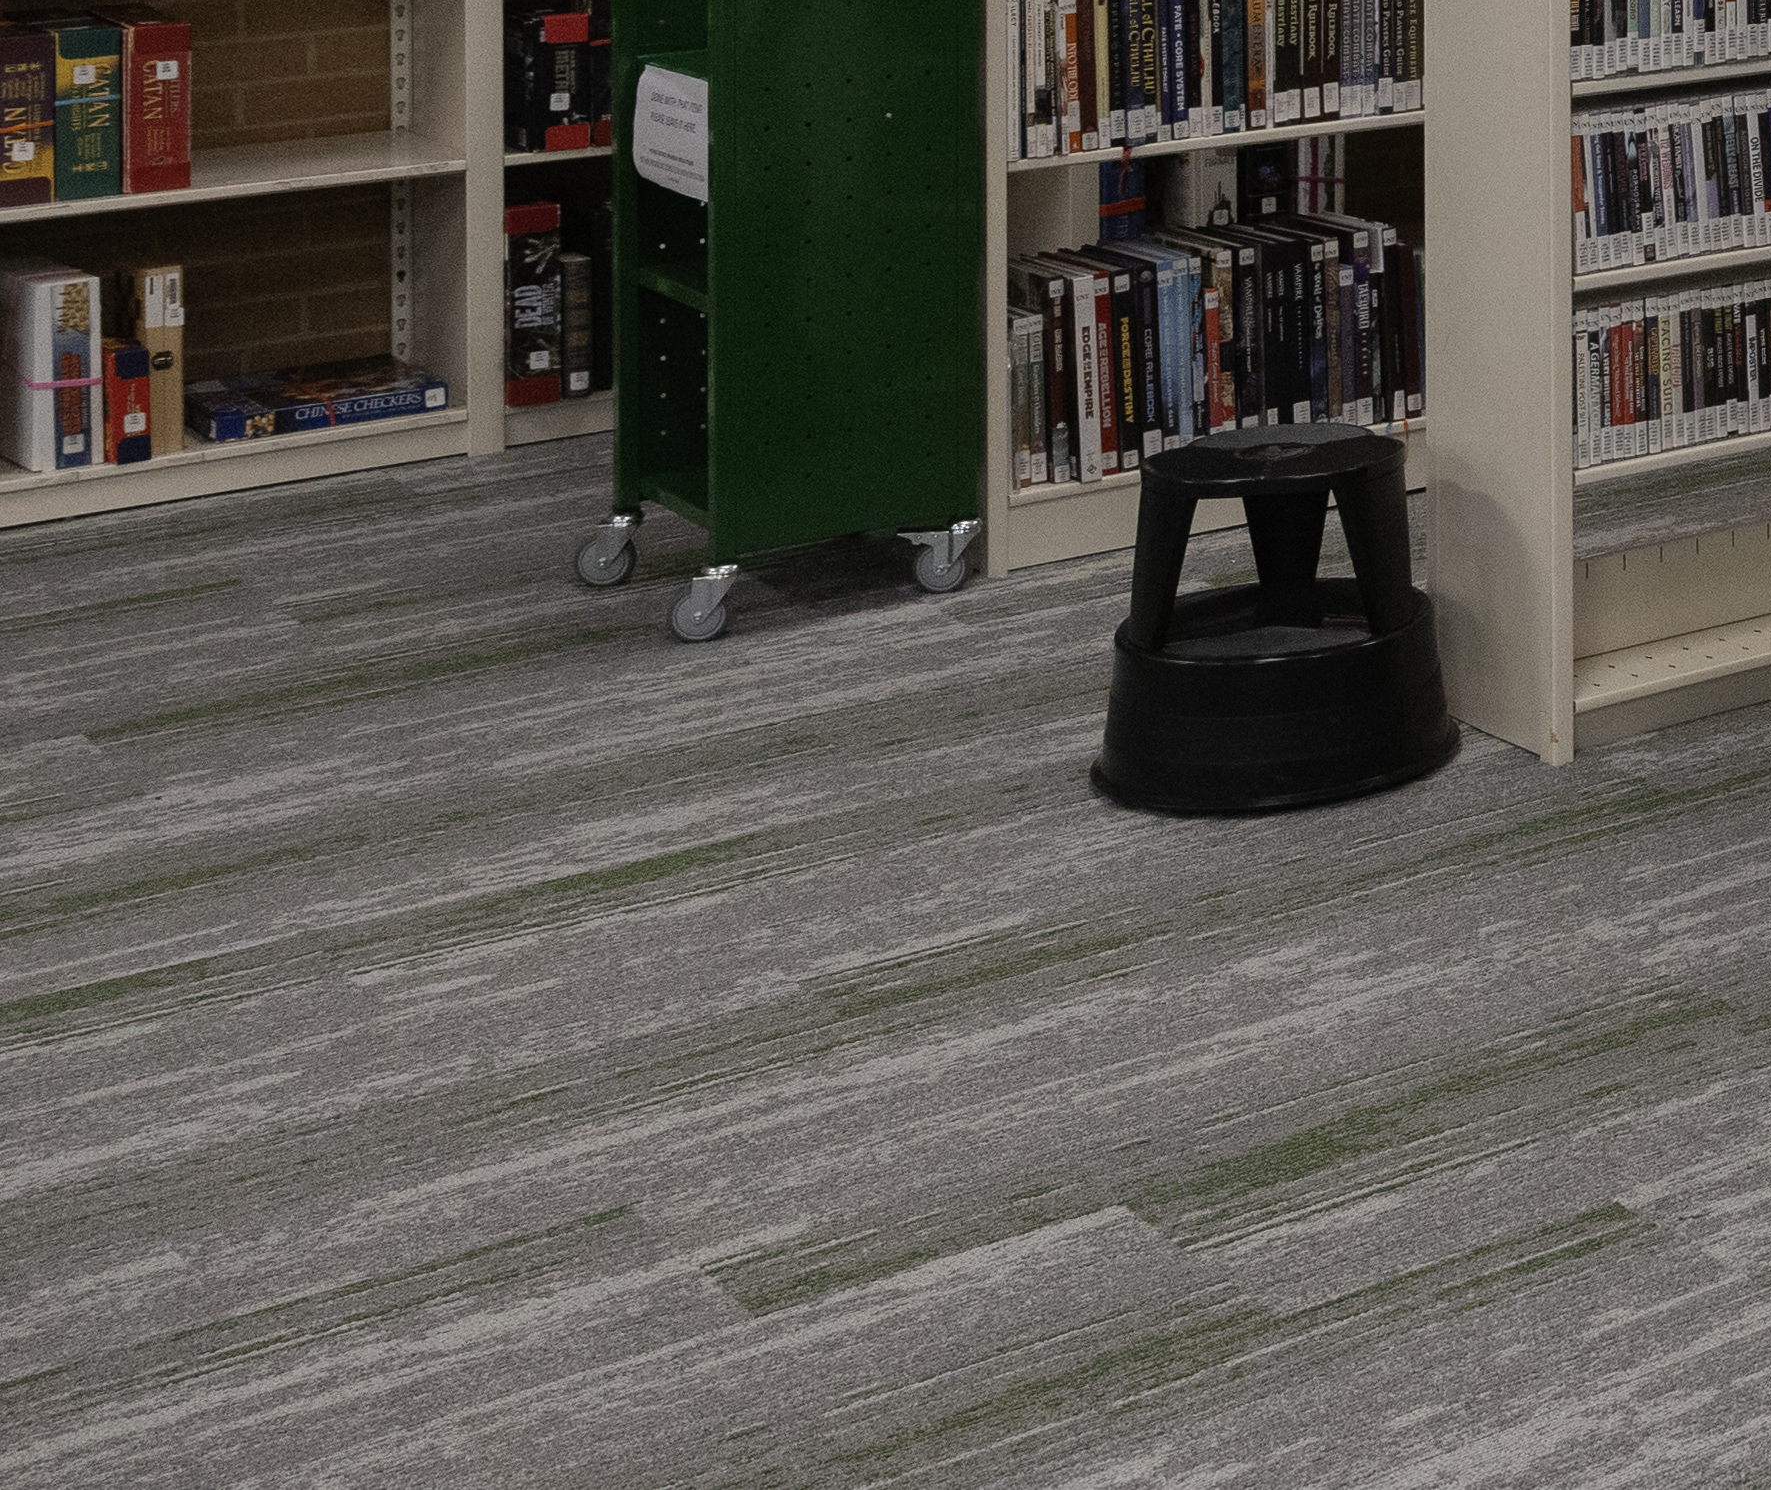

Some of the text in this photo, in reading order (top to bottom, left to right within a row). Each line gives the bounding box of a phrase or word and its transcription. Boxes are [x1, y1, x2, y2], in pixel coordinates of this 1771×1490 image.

[1174, 4, 1186, 112] FATE CORE SYSTEM
[1307, 4, 1319, 61] RULEBOOK
[1327, 4, 1338, 60] RULEBOOK
[1750, 136, 1763, 203] ON THE DIVIDE
[514, 284, 544, 329] DEAD
[1081, 325, 1094, 420] EDGE EMPIRE
[1144, 328, 1156, 423] CORE RULEBOOK
